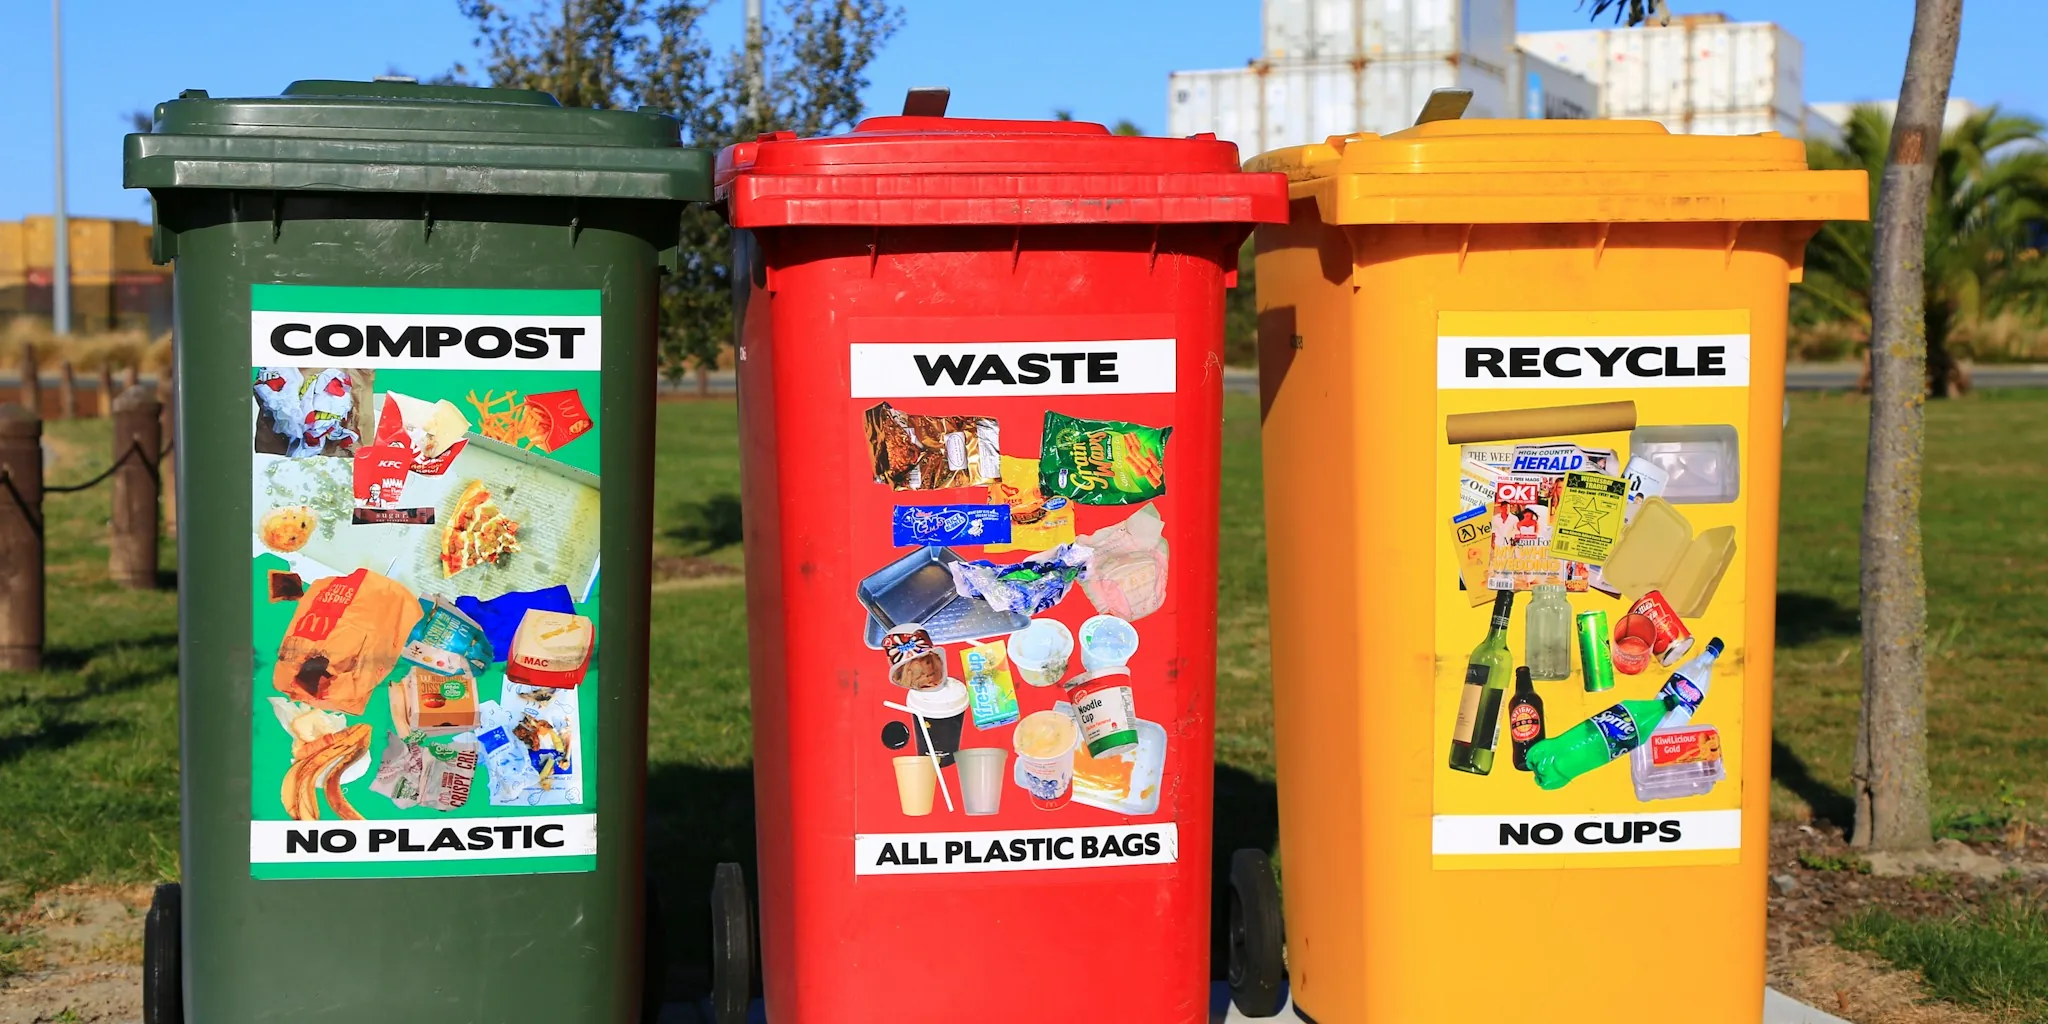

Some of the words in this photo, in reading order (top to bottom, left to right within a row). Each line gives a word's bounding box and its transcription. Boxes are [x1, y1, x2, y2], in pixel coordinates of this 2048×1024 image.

[270, 323, 586, 360] COMPOST
[913, 352, 1119, 386] WASTE
[1465, 345, 1726, 378] RECYCLE
[1468, 451, 1488, 461] THE
[1491, 452, 1513, 462] WEE
[1538, 448, 1575, 456] COUNTRY
[378, 460, 403, 469] KFC
[1069, 441, 1109, 491] Grain
[1512, 455, 1583, 471] HERALD
[1469, 479, 1495, 500] Otag
[1498, 484, 1537, 501] OK!
[1537, 537, 1551, 547] Fo
[523, 655, 550, 668] MAC
[969, 675, 995, 718] fresh
[1077, 698, 1104, 715] Noodle
[1081, 712, 1095, 724] Cup
[1593, 710, 1635, 735] Sprite
[1654, 734, 1697, 745] KiwiLicious
[1663, 743, 1681, 754] Gold
[449, 772, 476, 808] CRISPY
[286, 828, 357, 854] NO
[368, 823, 565, 854] PLASTIC
[1499, 822, 1564, 846] NO
[1573, 819, 1682, 845] CUPS
[875, 841, 938, 866] ALL
[944, 834, 1075, 865] PLASTIC
[1080, 832, 1161, 859] BAGS
